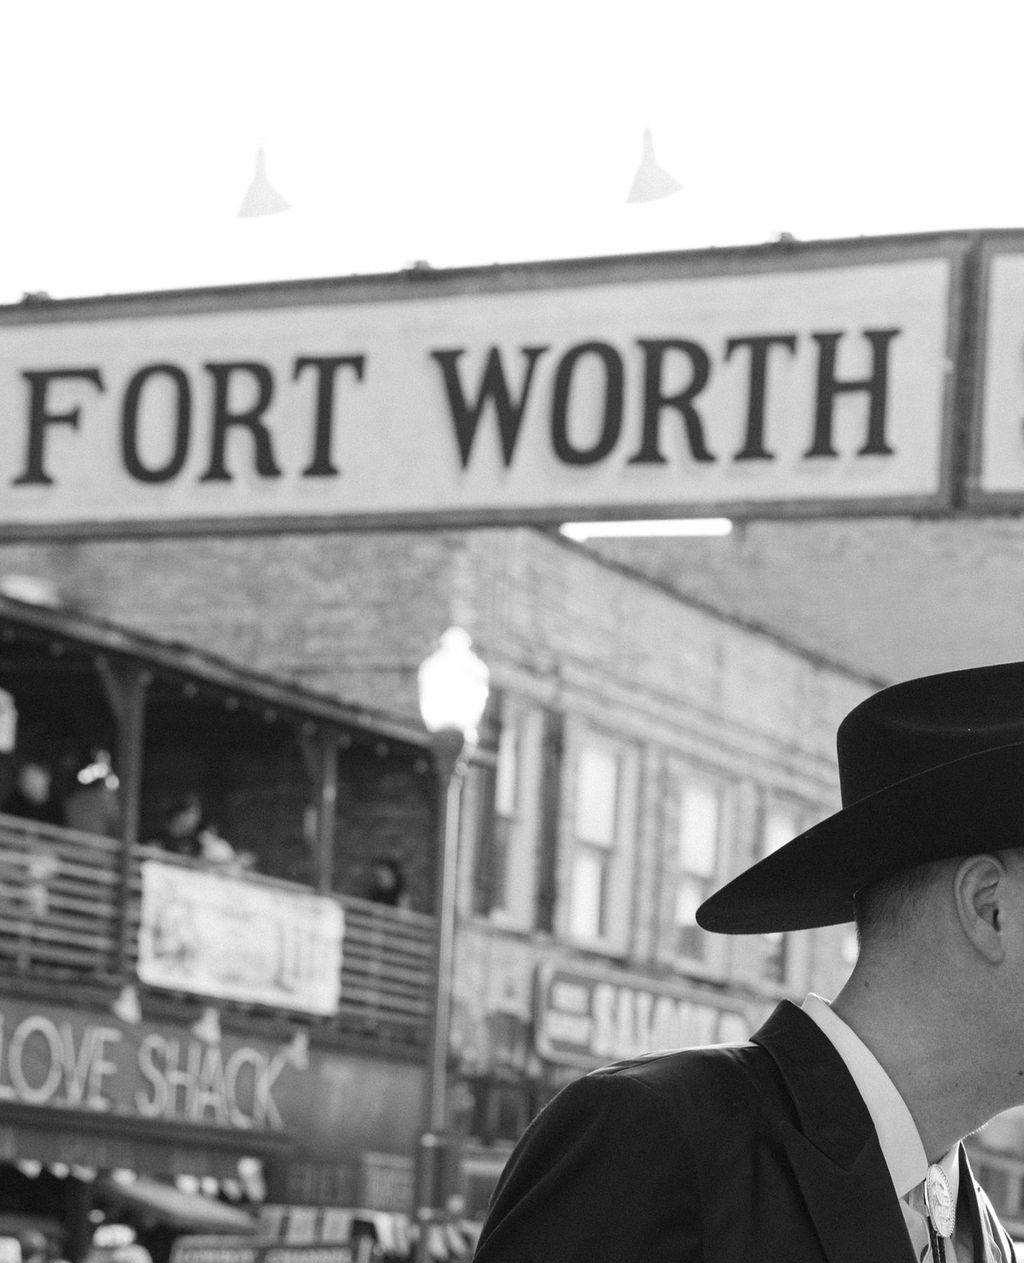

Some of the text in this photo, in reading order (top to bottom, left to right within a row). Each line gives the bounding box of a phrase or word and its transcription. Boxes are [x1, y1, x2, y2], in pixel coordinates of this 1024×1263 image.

[11, 353, 367, 489] FORT
[429, 327, 903, 472] WORTH
[135, 1033, 294, 1132] SHACK
